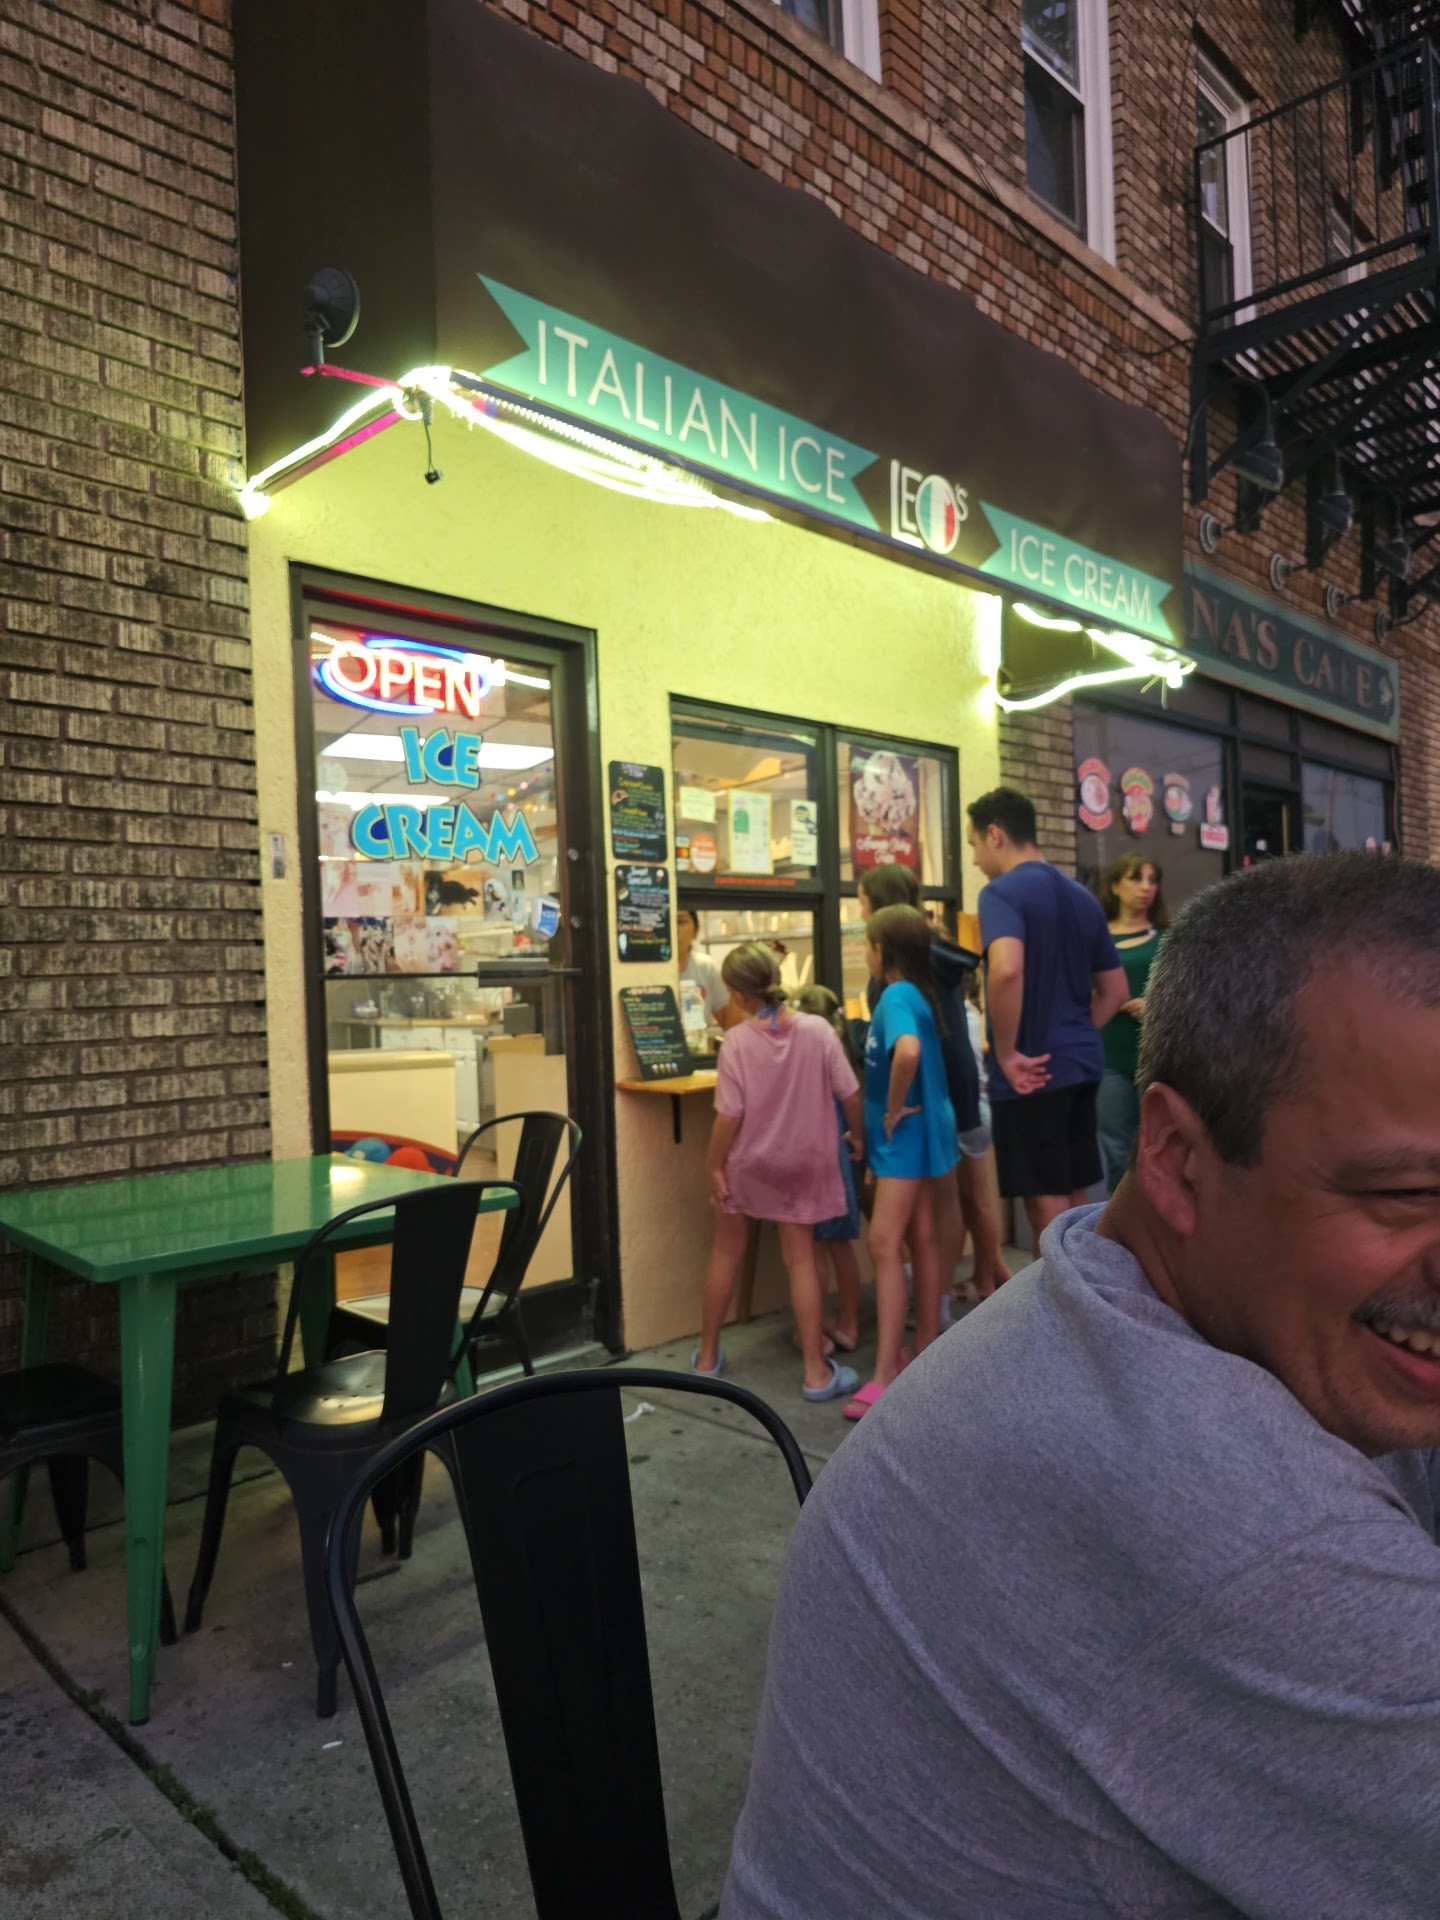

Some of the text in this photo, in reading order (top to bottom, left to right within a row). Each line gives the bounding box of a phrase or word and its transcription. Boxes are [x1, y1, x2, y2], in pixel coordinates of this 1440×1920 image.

[536, 319, 847, 505] ITALIAN ICE
[889, 457, 968, 556] LEO'S
[1009, 528, 1153, 624] ICE CREAM
[328, 641, 481, 718] OPEN
[400, 726, 483, 788] ICE
[351, 802, 541, 866] CREAM
